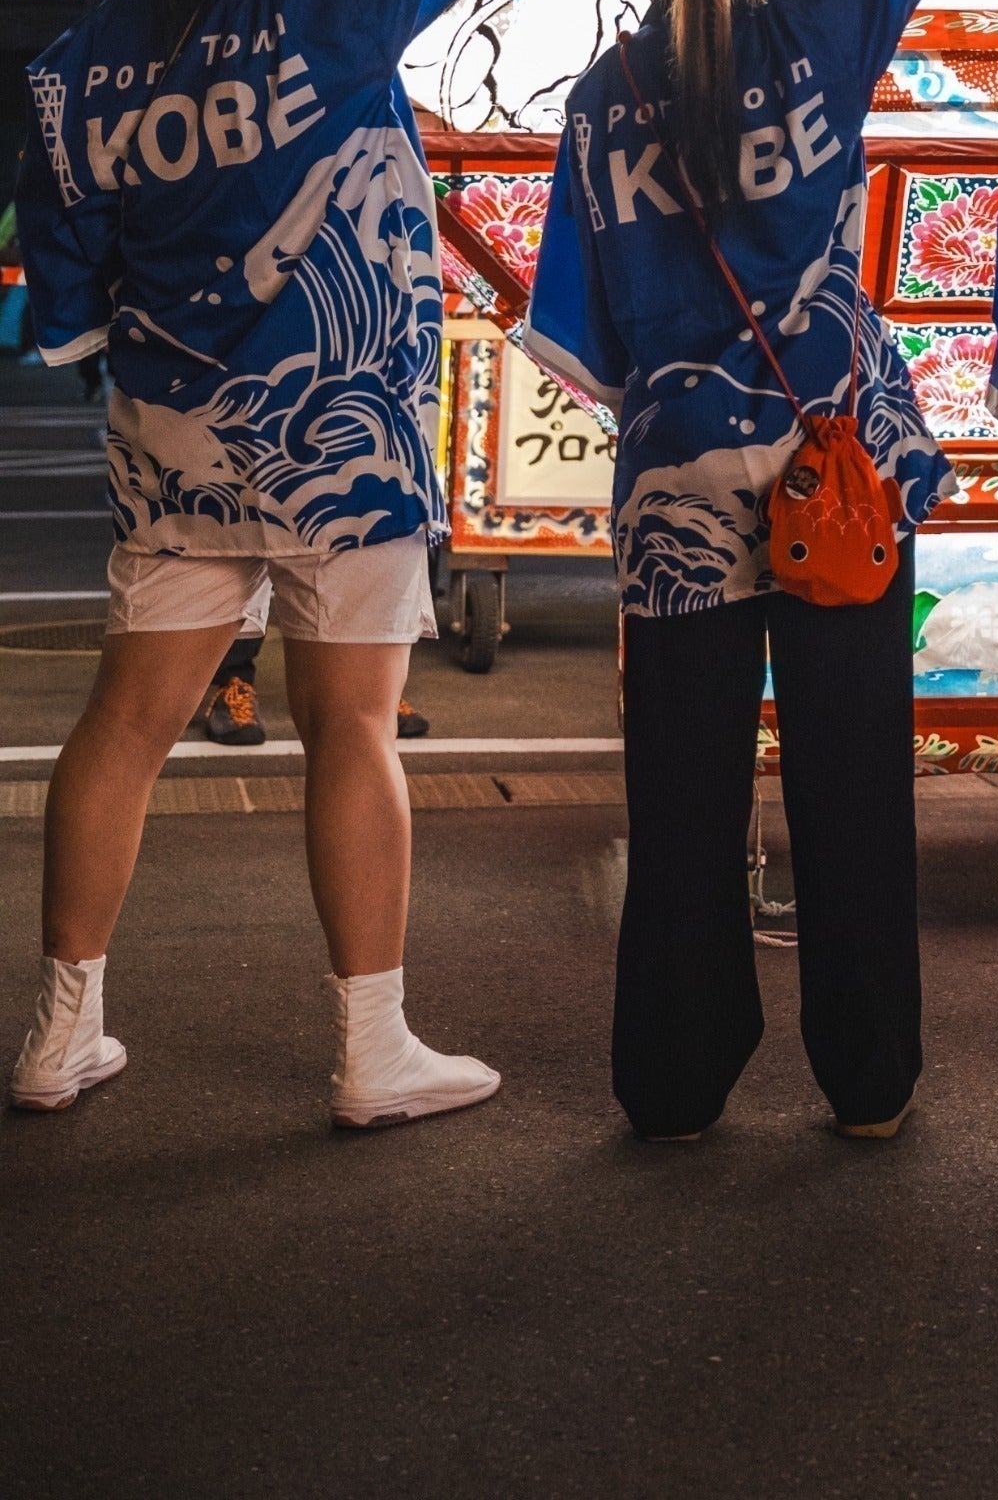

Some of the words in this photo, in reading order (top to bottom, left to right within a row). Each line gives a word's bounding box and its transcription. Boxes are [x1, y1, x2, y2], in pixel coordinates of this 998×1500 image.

[85, 55, 181, 97] Por
[608, 100, 672, 133] Por
[86, 54, 326, 190] KOBE
[608, 91, 842, 224] KBE
